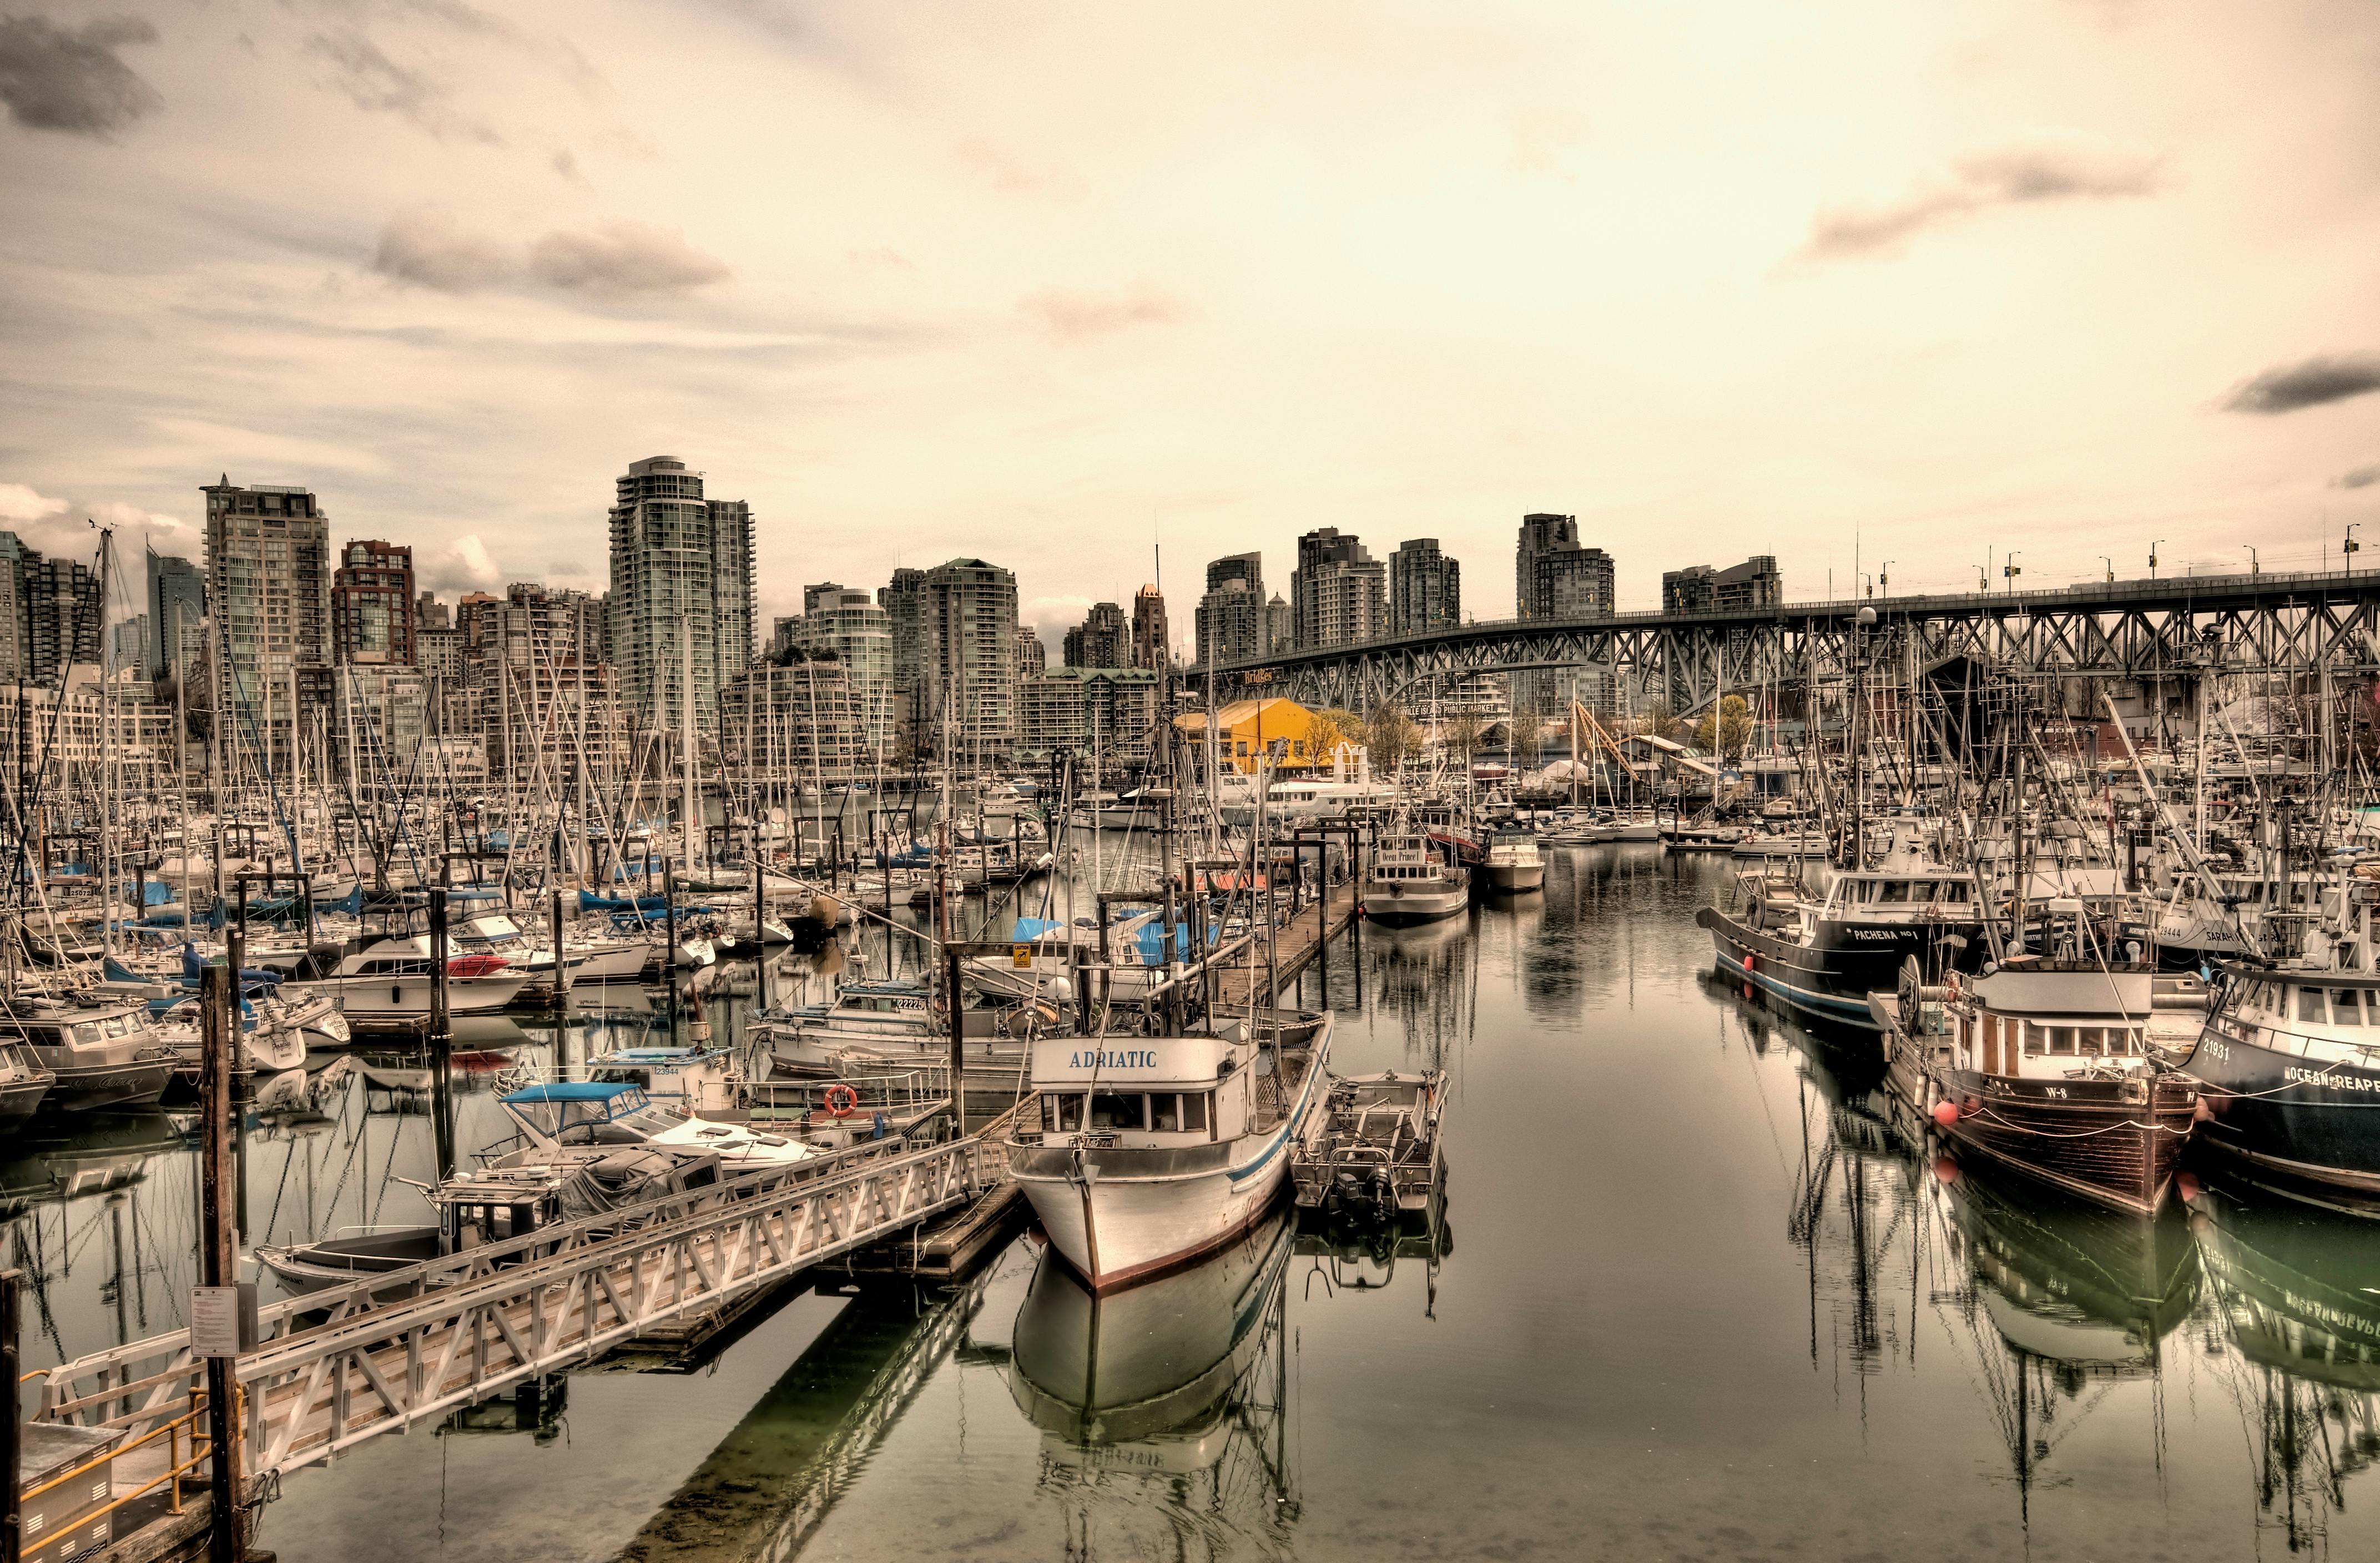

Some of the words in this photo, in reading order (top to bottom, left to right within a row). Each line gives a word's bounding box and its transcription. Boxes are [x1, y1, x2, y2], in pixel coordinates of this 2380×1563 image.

[1244, 668, 1273, 684] Bridges
[1391, 707, 1419, 716] RANVILLE
[1444, 705, 1466, 714] PUBLIC
[1468, 704, 1495, 713] MARKET
[1399, 851, 1416, 861] Prince
[1854, 930, 1898, 940] PACHENA
[2160, 926, 2181, 938] 29444
[2206, 931, 2235, 942] SARAH
[2203, 1037, 2230, 1061] 21931
[1069, 1051, 1157, 1068] ADRIATIC
[2290, 1066, 2329, 1086] OCEAN
[2045, 1087, 2068, 1099] W-8
